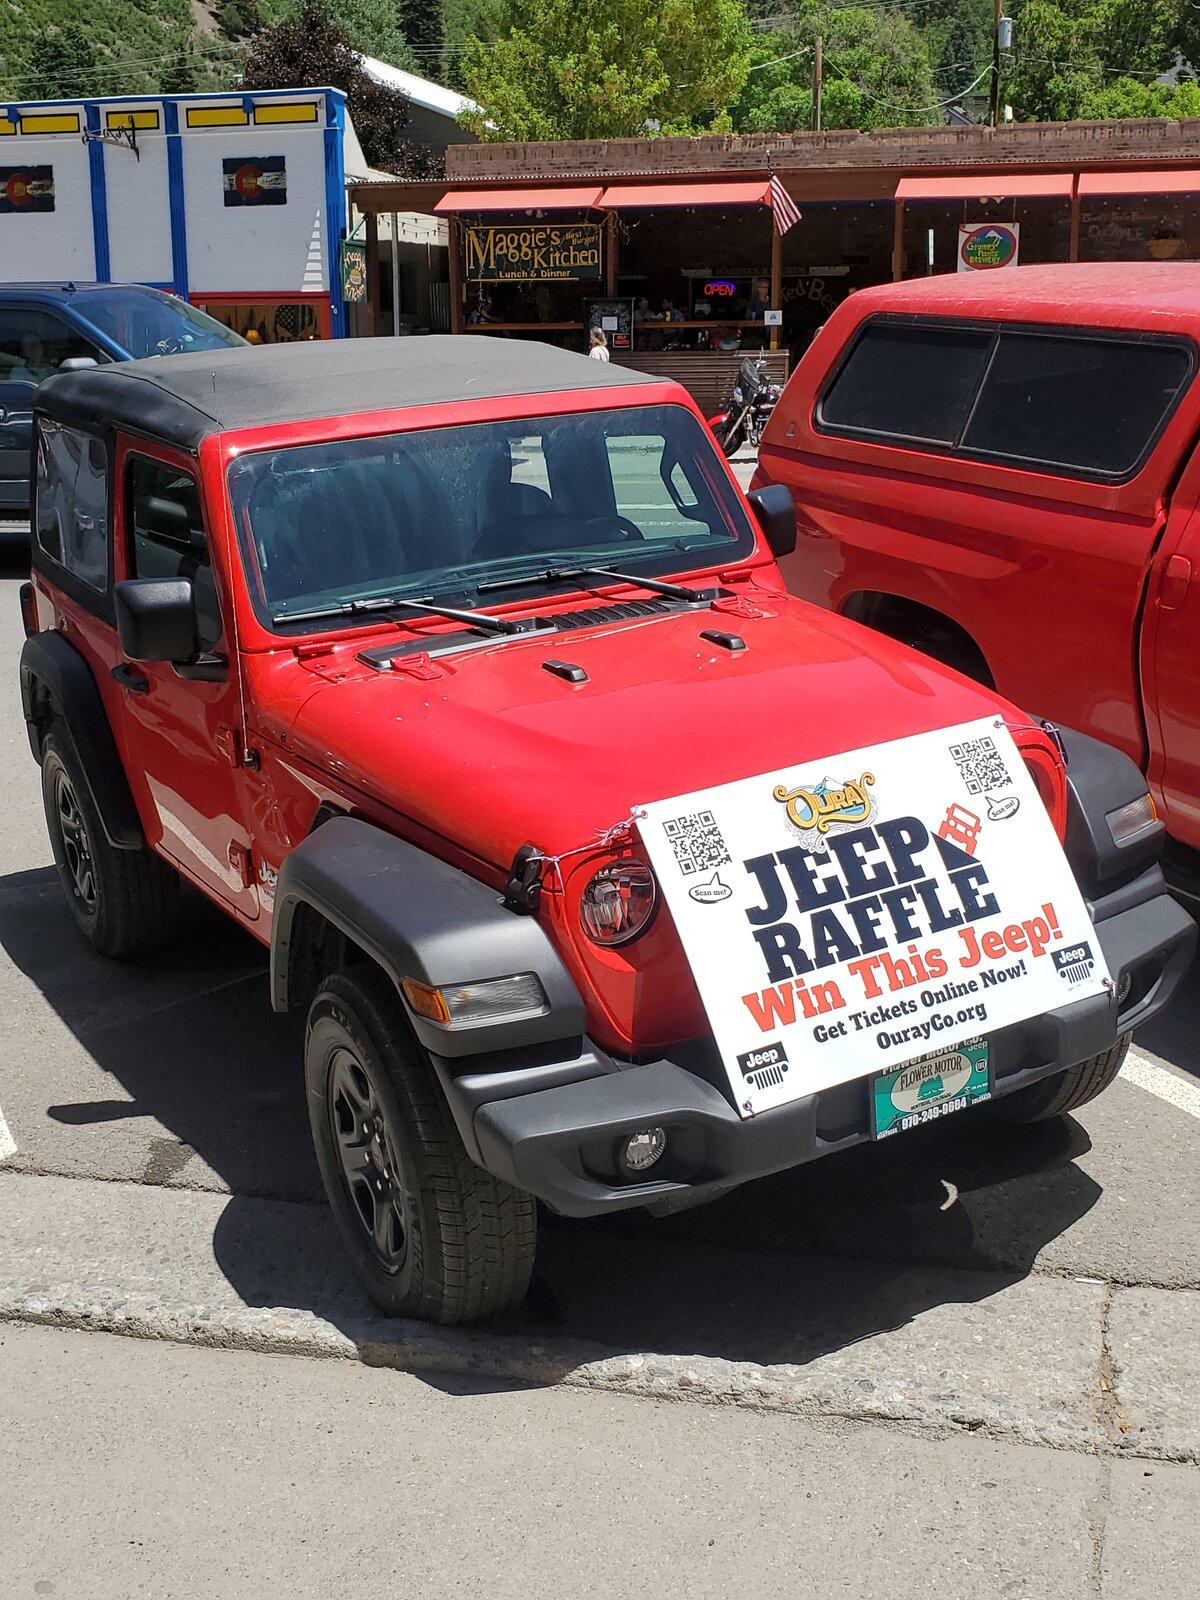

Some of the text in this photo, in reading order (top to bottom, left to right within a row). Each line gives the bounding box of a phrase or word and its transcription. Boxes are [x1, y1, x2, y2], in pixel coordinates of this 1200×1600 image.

[468, 228, 562, 269] Maggie's
[533, 245, 599, 269] Kitchen
[499, 269, 571, 279] Lunch & Dinner
[703, 282, 735, 297] OPEN
[742, 816, 930, 926] JEEP
[752, 864, 1001, 984] RAFFLE
[741, 902, 1064, 1033] Win This Jeep!
[1058, 947, 1086, 964] Jeep
[813, 959, 1029, 1044] Get Tickets Online Now!
[876, 1002, 989, 1050] OurayCo.org
[746, 1049, 779, 1068] Jeep
[900, 1055, 963, 1092] FLOWER MOTOR
